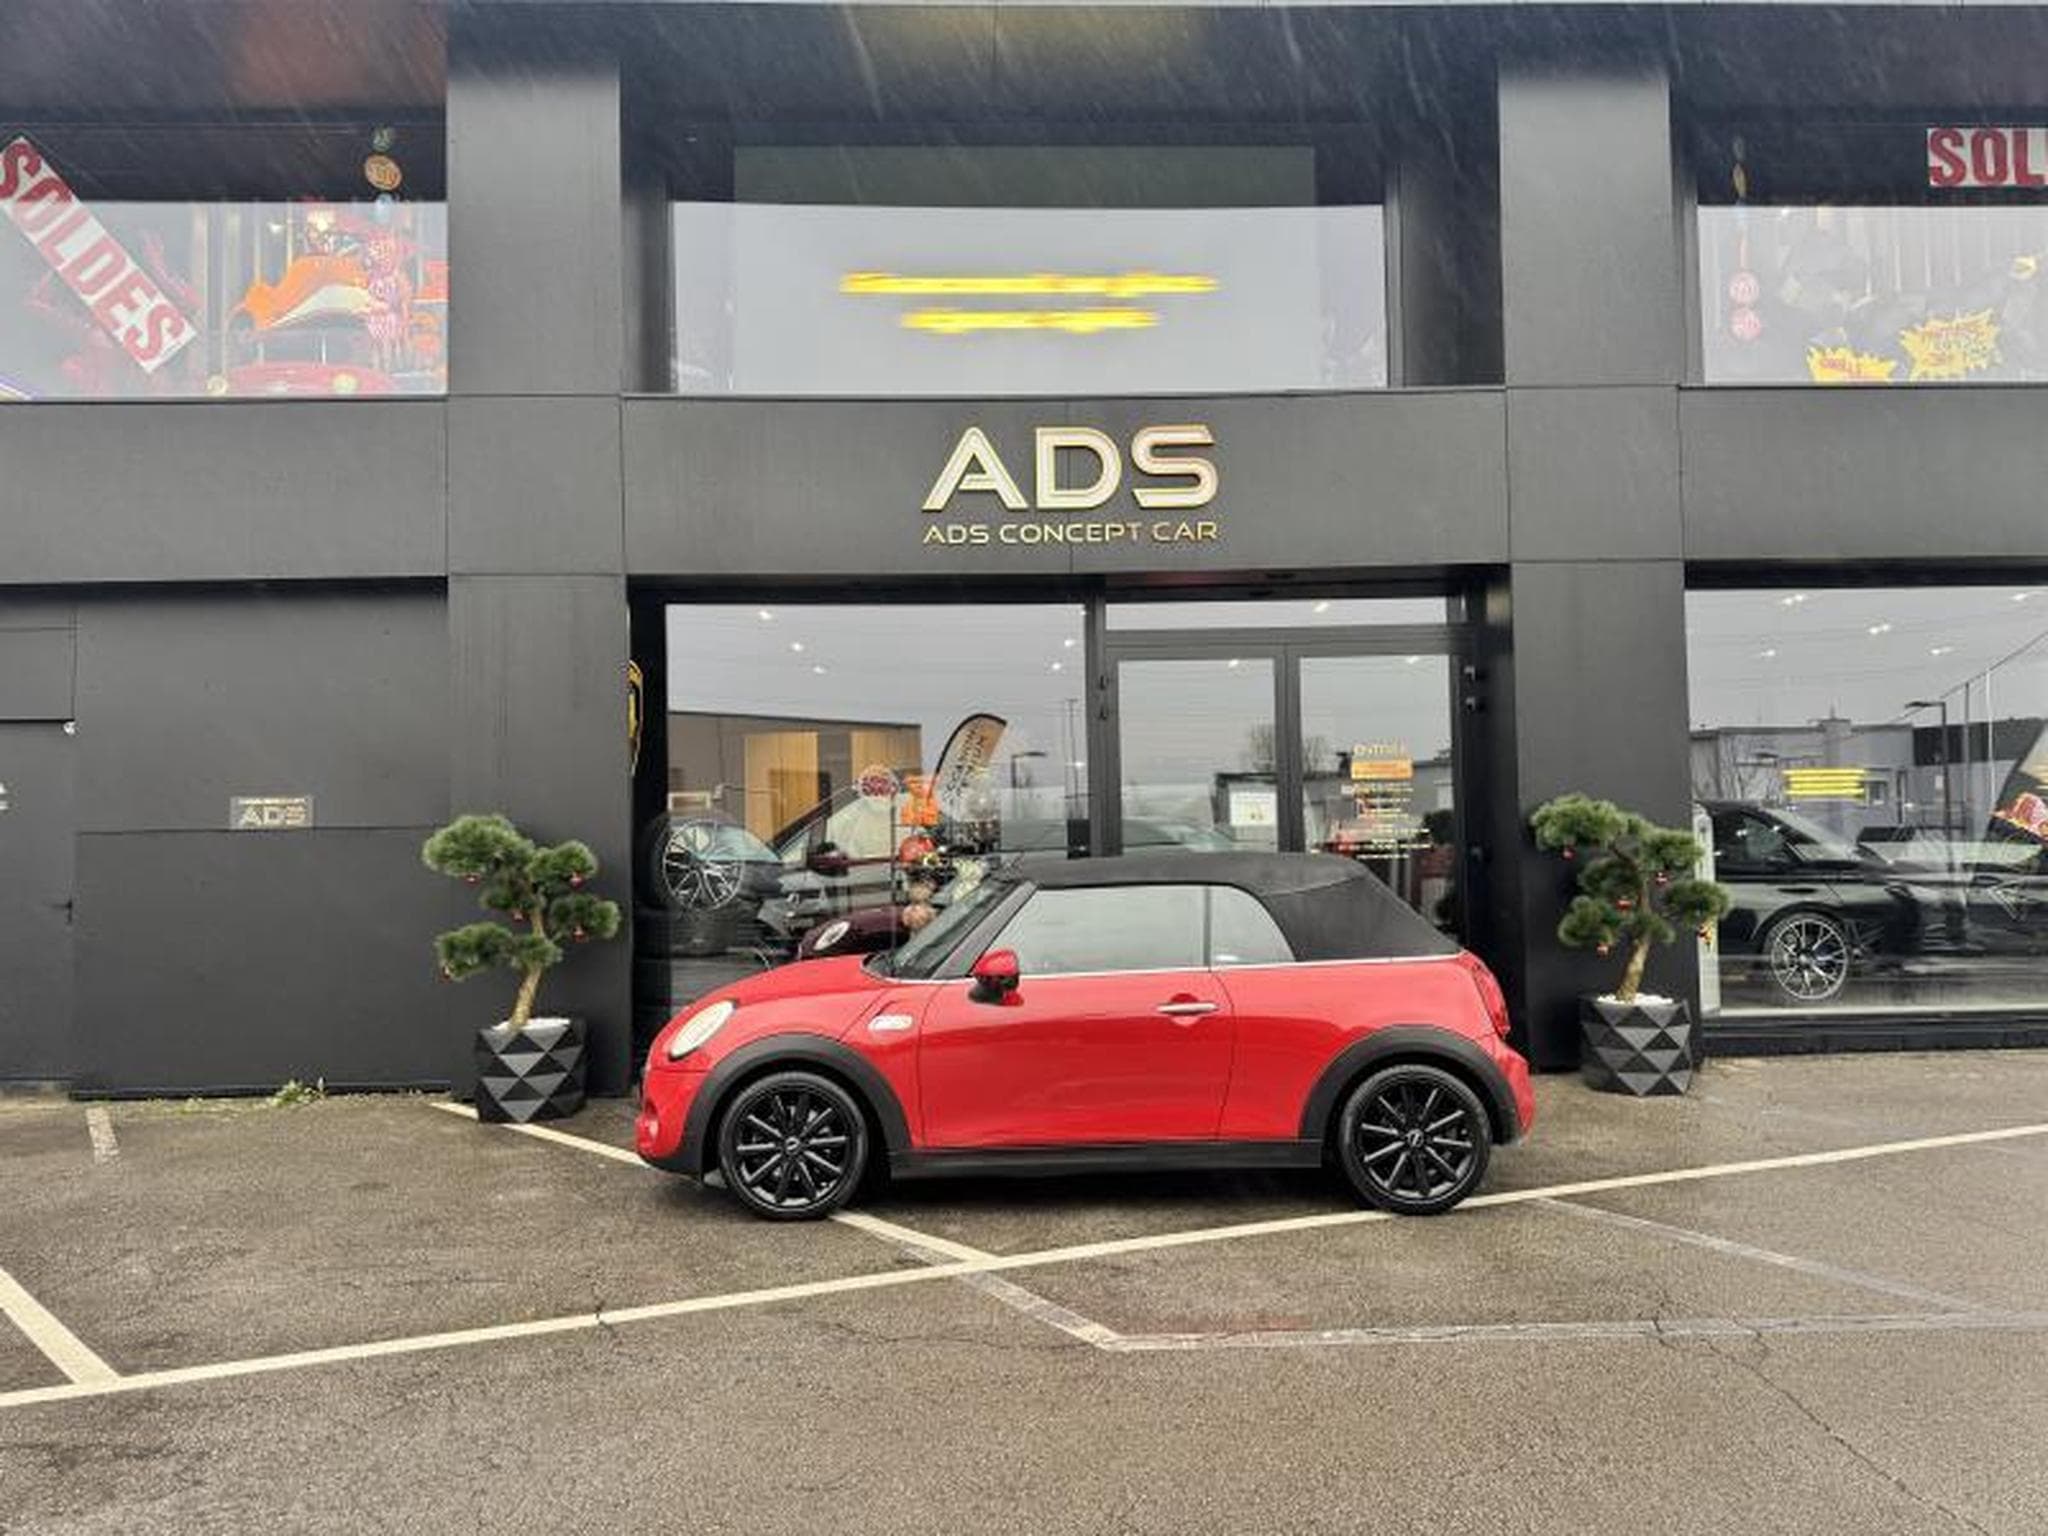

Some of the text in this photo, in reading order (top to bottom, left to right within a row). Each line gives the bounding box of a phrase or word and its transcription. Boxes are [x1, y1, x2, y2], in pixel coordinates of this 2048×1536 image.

[1929, 128, 2048, 185] SOL
[0, 142, 185, 362] SOLDES
[922, 425, 1218, 510] ADS
[923, 521, 1218, 545] ADS CONCEPT CAR
[240, 805, 305, 826] ADS
